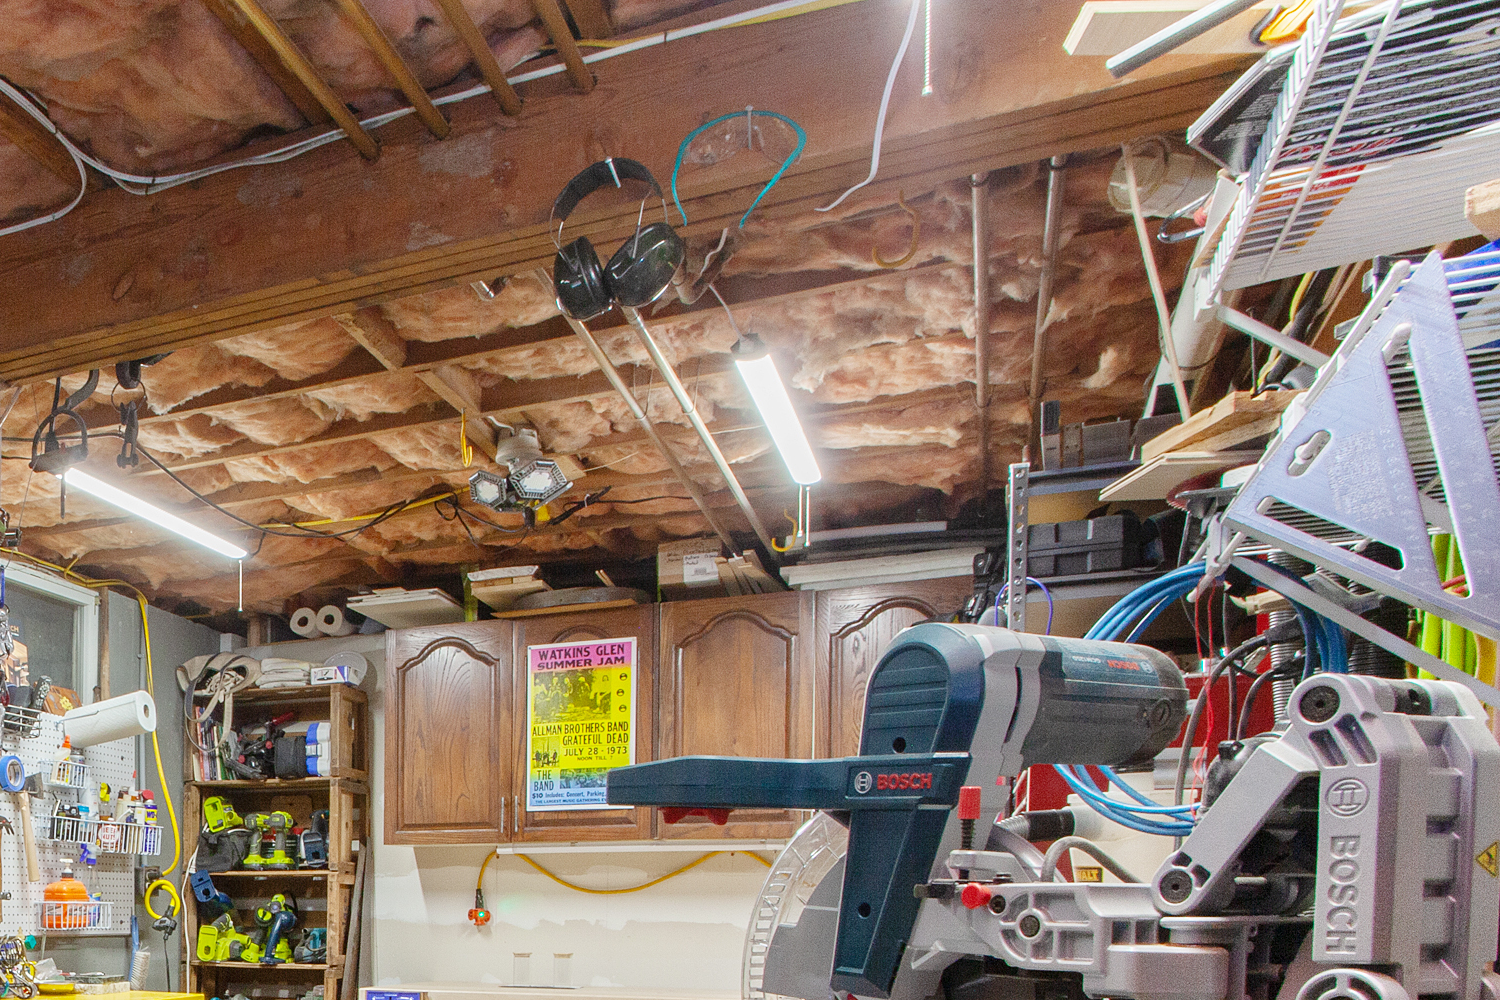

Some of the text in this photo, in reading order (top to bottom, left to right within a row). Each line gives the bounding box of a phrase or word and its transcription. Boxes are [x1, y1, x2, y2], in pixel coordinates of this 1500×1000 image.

[538, 643, 625, 661] WATKINS GLEN
[537, 655, 625, 671] SUMMER JAM
[1106, 659, 1140, 671] BOSCH
[532, 721, 629, 736] ALLMAN BROTHERS BAND
[562, 732, 629, 746] GRATEFUL DEAD
[564, 747, 584, 757] JULY
[587, 747, 599, 755] 28
[607, 746, 628, 754] 1973
[536, 769, 552, 780] THE
[876, 772, 933, 790] BOSCH
[534, 780, 554, 791] BAND
[1325, 834, 1362, 956] BOSCH
